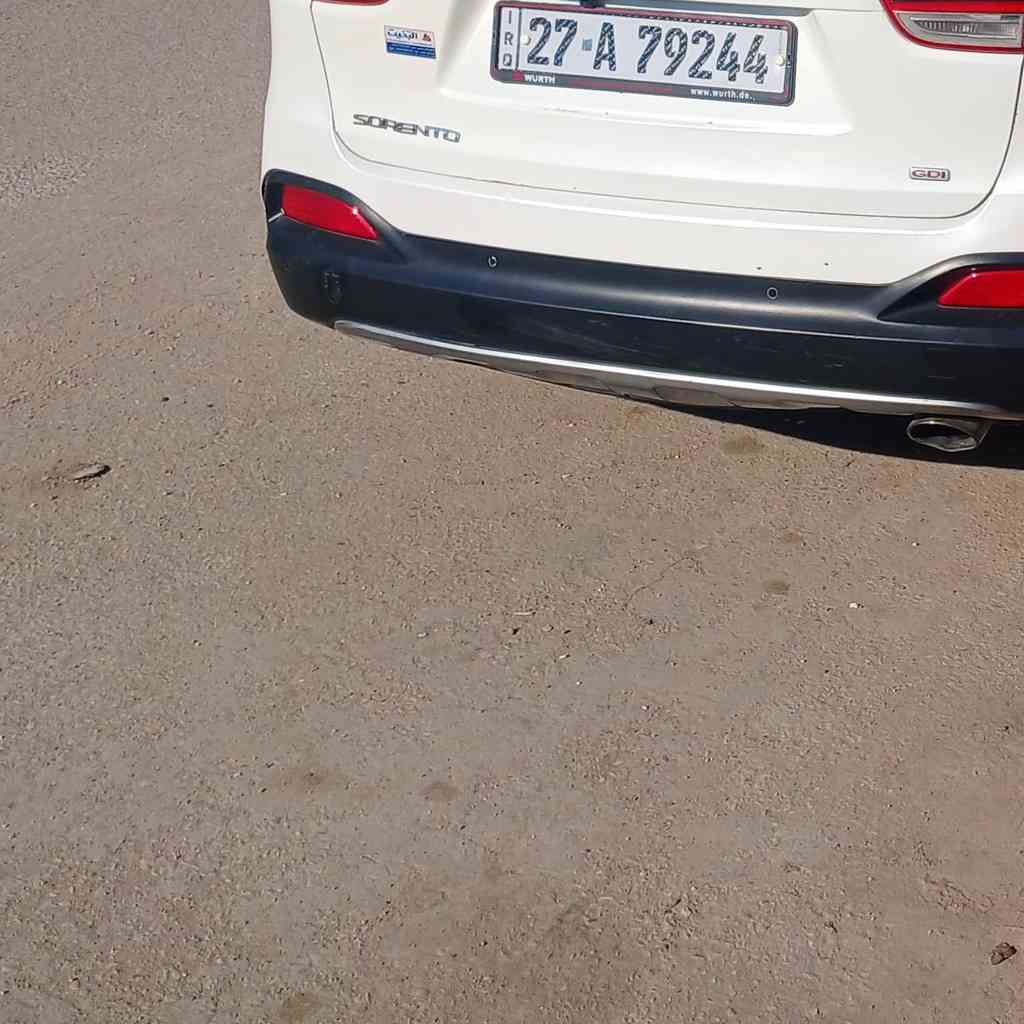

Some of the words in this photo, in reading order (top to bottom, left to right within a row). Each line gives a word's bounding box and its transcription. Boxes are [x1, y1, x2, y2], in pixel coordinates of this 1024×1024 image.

[527, 17, 577, 67] 27
[593, 22, 616, 72] A
[637, 25, 768, 85] 79244
[353, 114, 461, 144] SORENTO
